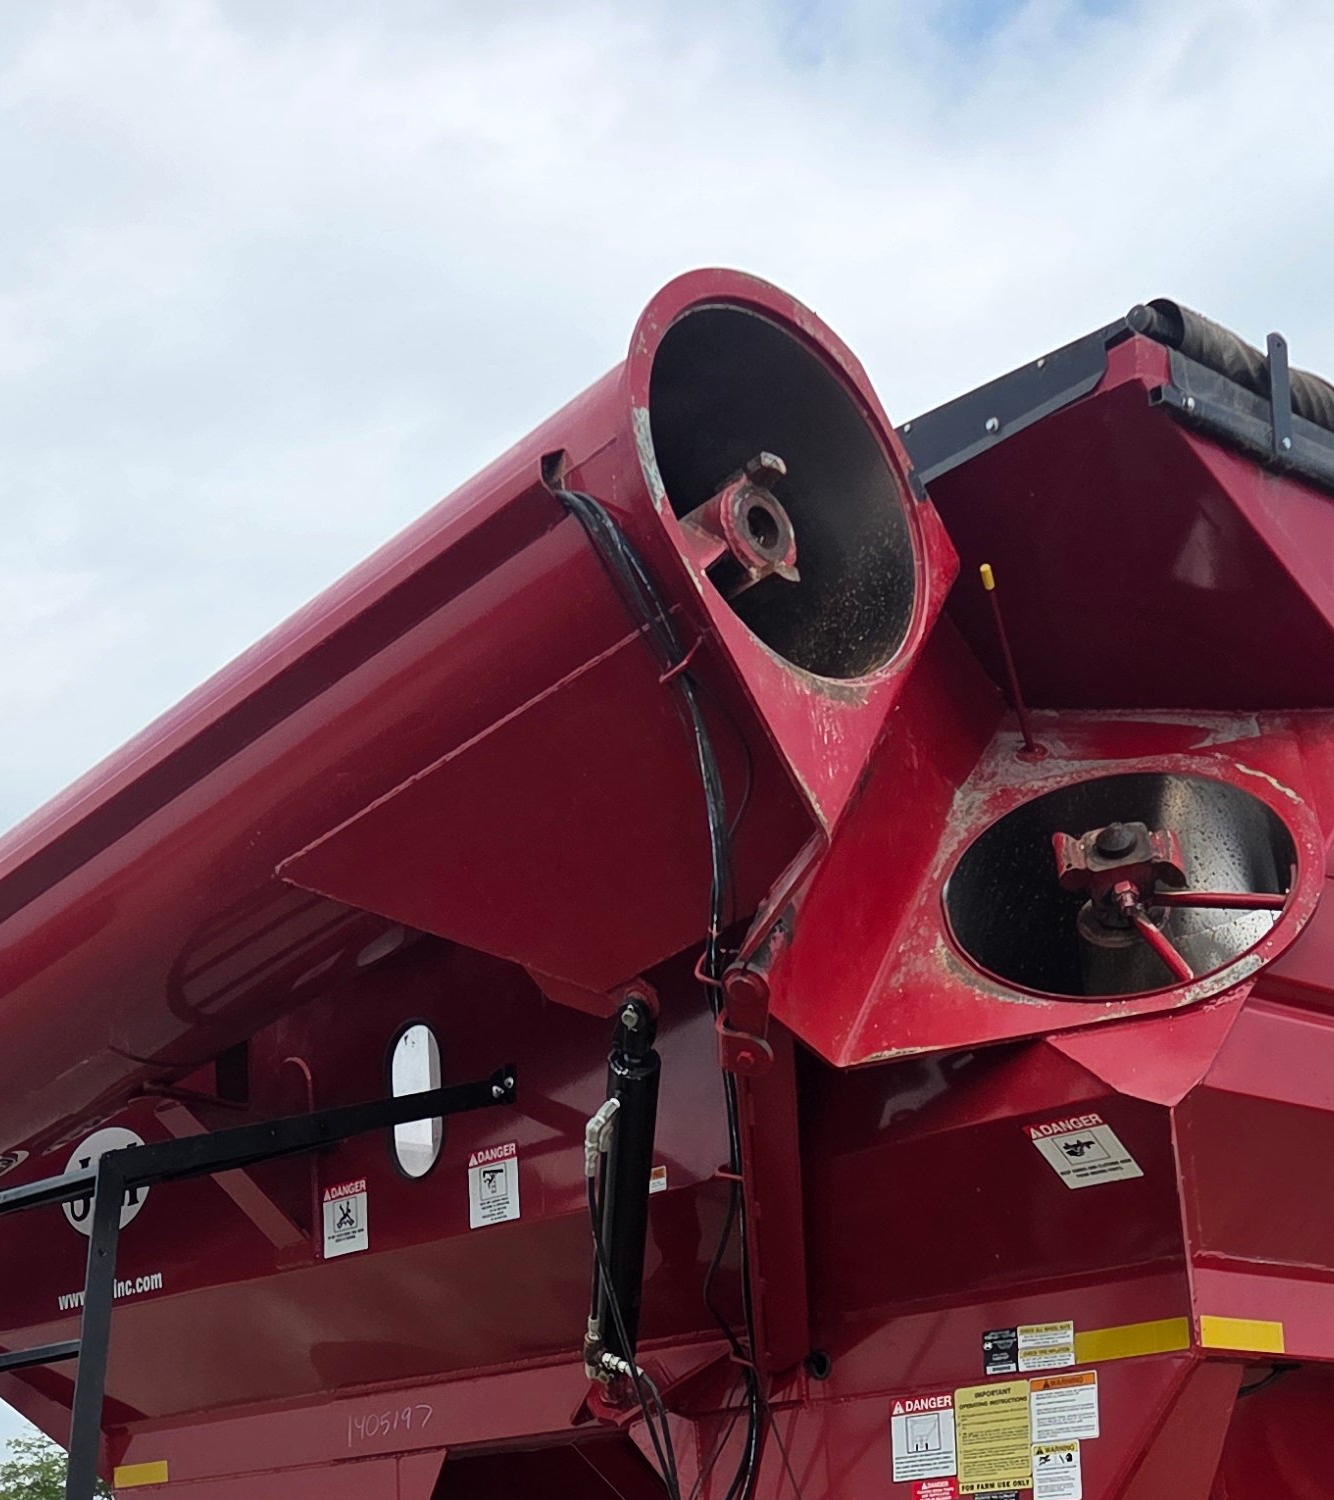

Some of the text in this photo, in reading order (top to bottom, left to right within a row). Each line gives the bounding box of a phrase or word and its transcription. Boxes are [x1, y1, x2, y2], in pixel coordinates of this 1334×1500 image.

[1039, 1112, 1104, 1136] DANGER
[477, 1142, 517, 1165] DANGER
[331, 1179, 367, 1200] DANGER
[905, 1394, 953, 1412] DANGER
[348, 1404, 433, 1448] 1405197
[961, 1478, 1031, 1493] FOR FARM USE ONLY
